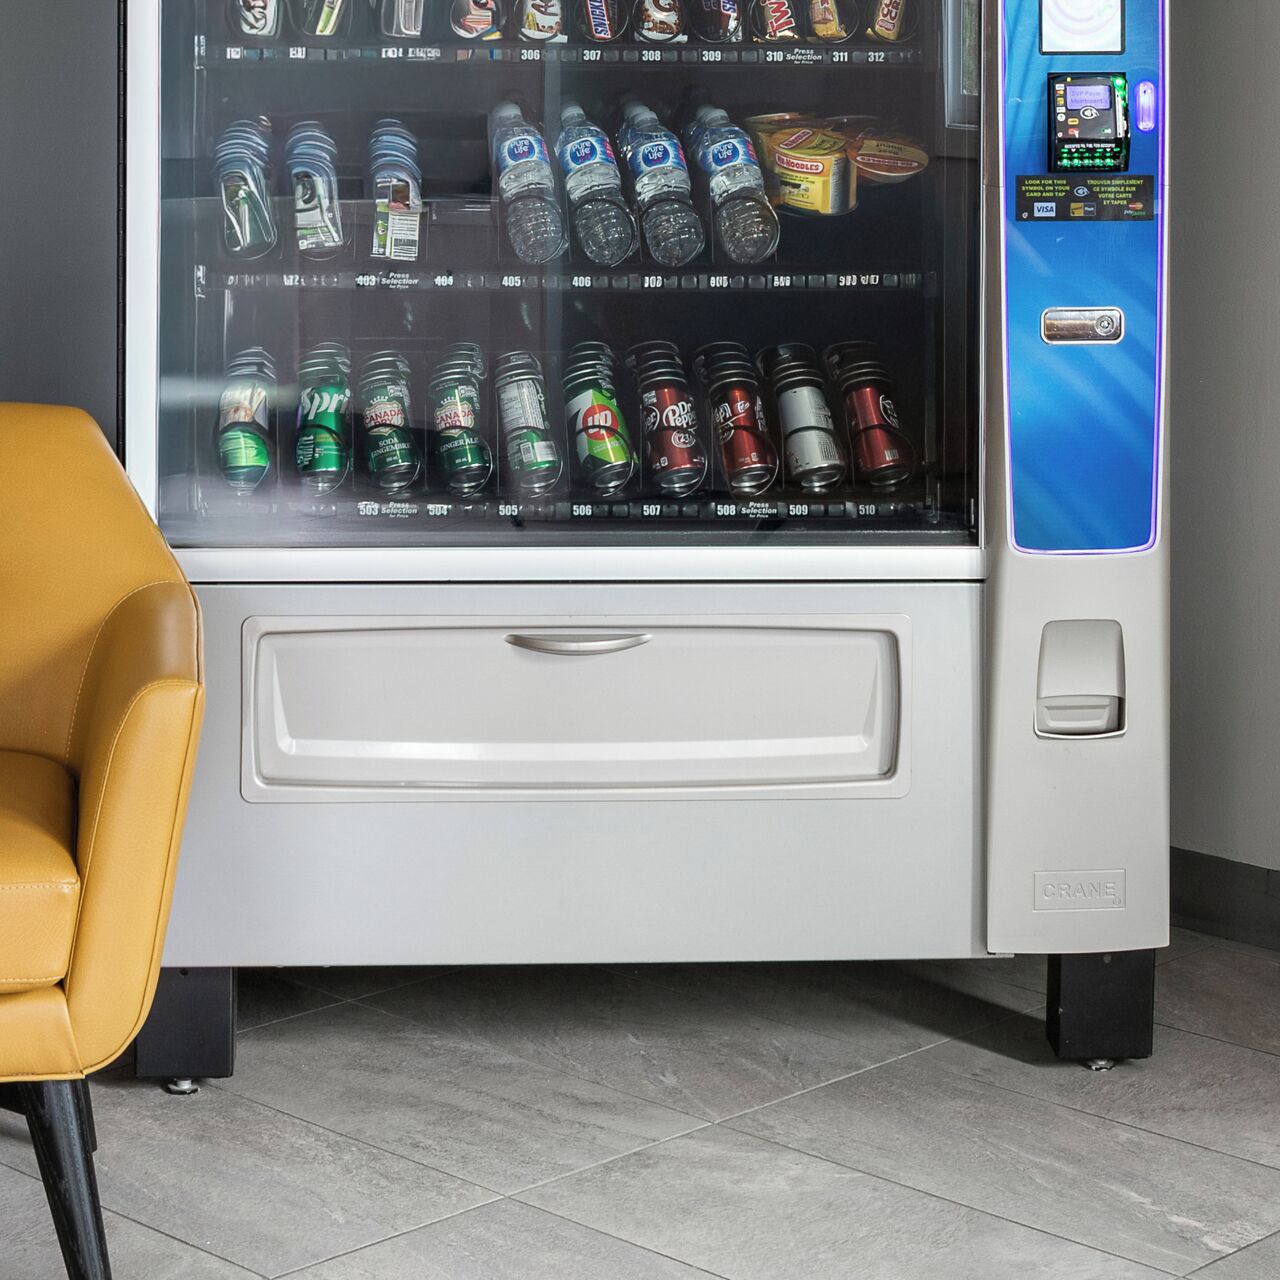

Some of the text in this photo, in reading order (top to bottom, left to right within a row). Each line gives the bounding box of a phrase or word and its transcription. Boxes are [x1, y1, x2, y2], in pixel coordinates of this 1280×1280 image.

[521, 49, 540, 60] 306
[583, 50, 601, 61] 307
[642, 50, 661, 61] 308
[702, 51, 721, 62] 309
[766, 51, 783, 62] 310
[833, 52, 848, 63] 311
[868, 52, 885, 63] 312
[510, 139, 530, 148] Pure
[572, 141, 591, 152] Pure
[645, 144, 664, 154] Pure
[714, 143, 733, 153] Pure
[514, 146, 529, 155] Life
[576, 148, 591, 158] Life
[719, 150, 733, 160] Life
[649, 152, 663, 161] Life
[502, 276, 521, 287] 405
[572, 276, 592, 287] 406
[678, 401, 692, 415] Dr
[365, 408, 404, 425] CANADA
[436, 409, 474, 425] CANADA
[379, 437, 400, 448] SODA
[441, 440, 465, 452] GINGER
[360, 504, 379, 516] 503
[429, 505, 448, 516] 504
[499, 505, 518, 516] 505
[573, 505, 592, 516] 506
[643, 505, 661, 516] 507
[717, 505, 736, 516] 508
[789, 505, 809, 516] 509
[859, 506, 876, 516] 510
[1044, 882, 1117, 900] CRANE
